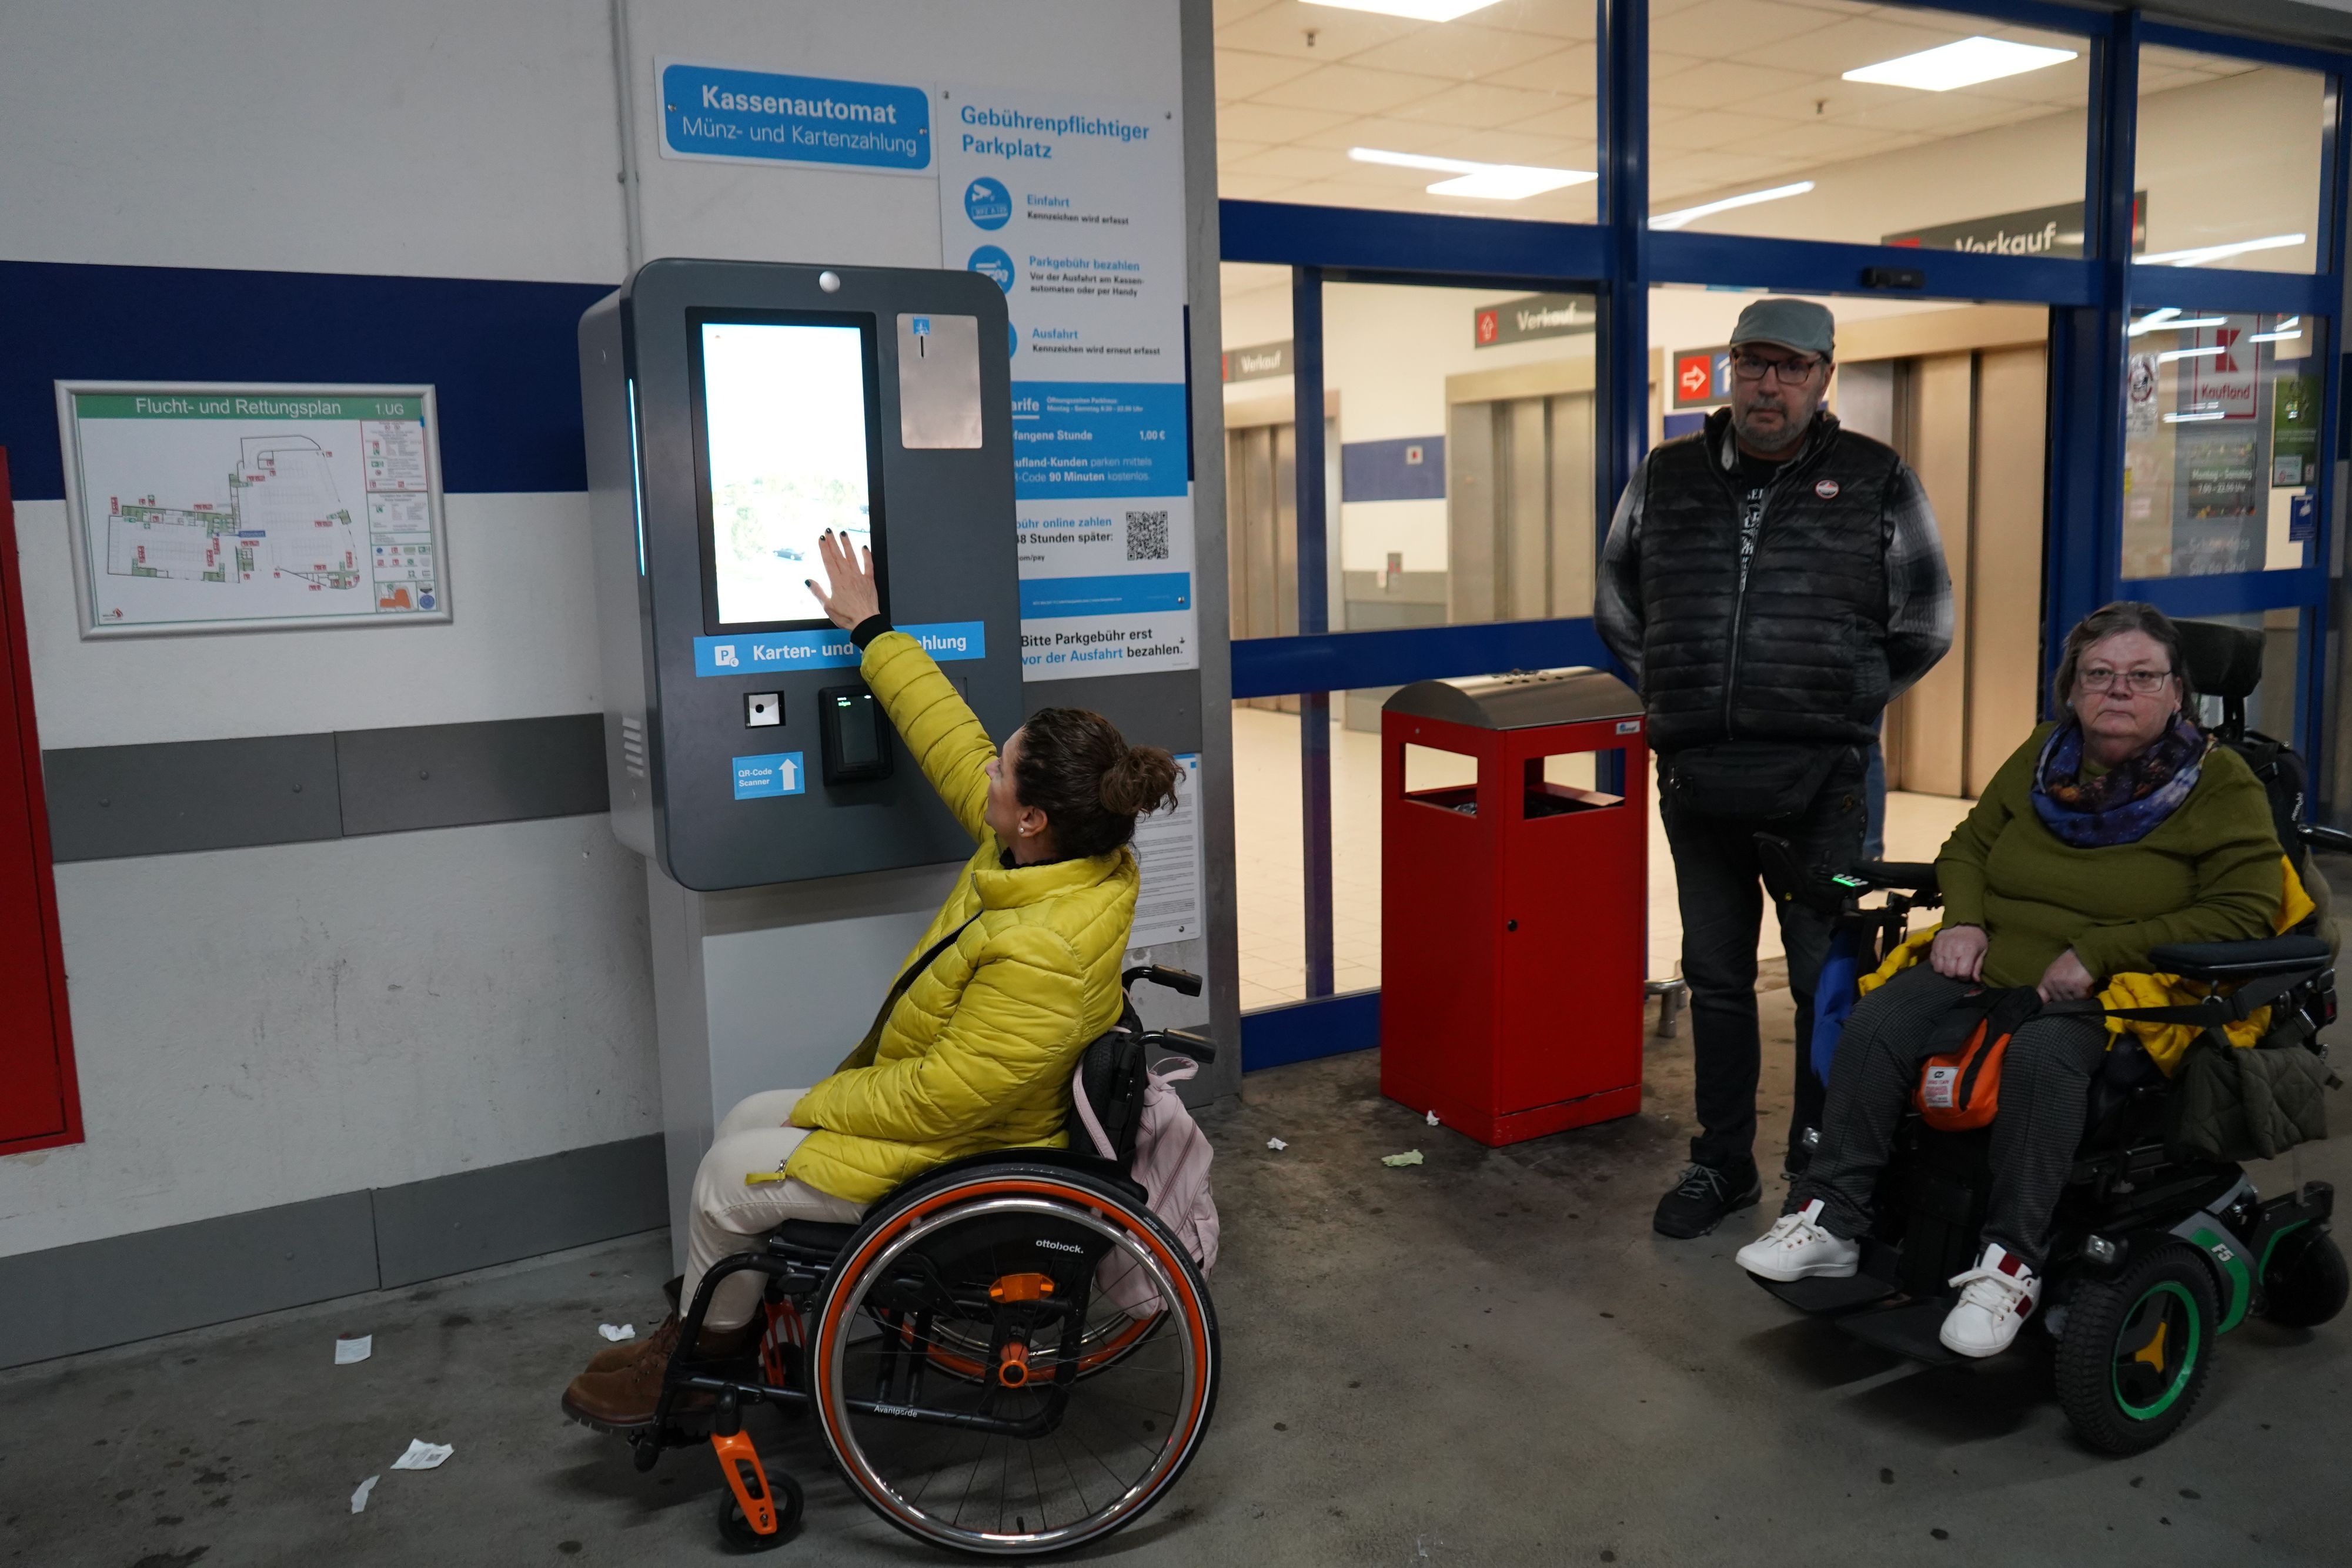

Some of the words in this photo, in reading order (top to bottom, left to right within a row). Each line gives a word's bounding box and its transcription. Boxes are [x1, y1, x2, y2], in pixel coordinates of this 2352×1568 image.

[703, 85, 897, 124] Kassenautomat
[961, 105, 1150, 142] Gebührenpflichtiger
[683, 116, 743, 140] Münz-
[750, 125, 784, 143] und
[793, 125, 917, 158] Kartenzahlung
[962, 134, 1053, 160] Parkplatz
[1027, 194, 1070, 208] Einfahrt
[1027, 211, 1079, 223] Kennzeichen
[1081, 214, 1100, 224] wird
[1102, 216, 1129, 226] erfasst
[1956, 221, 2056, 255] Verkauf
[1030, 255, 1090, 270] Parkgebühr
[1094, 259, 1140, 271] bezahlen
[1030, 272, 1044, 280] Vor
[1047, 272, 1060, 281] der
[1062, 273, 1097, 283] Ausfahrt
[1114, 276, 1144, 285] Kassen-
[1030, 285, 1075, 294] automaten
[1077, 286, 1095, 295] oder
[1097, 288, 1111, 296] per
[1112, 287, 1138, 297] Handy
[1516, 302, 1576, 332] Verkauf
[1032, 327, 1078, 340] Ausfahrt
[1032, 344, 1084, 353] Kennzeichen
[1087, 345, 1104, 354] wird
[1106, 346, 1132, 355] erneut
[1134, 346, 1161, 355] erfasst
[1241, 350, 1282, 372] Verkauf
[2201, 383, 2251, 400] Kaufland
[135, 397, 194, 414] Flucht-
[200, 399, 230, 414] und
[236, 399, 342, 418] Rettungsplan
[376, 402, 404, 415] 1.UG
[1013, 430, 1054, 442] fangene
[1057, 430, 1093, 441] Stunde
[1160, 430, 1165, 440] €
[1014, 457, 1087, 468] ufland-Kunden
[1091, 457, 1120, 468] parken
[1122, 456, 1152, 467] mittels
[1048, 472, 1061, 482] 90
[1064, 471, 1105, 482] Minuten
[1108, 471, 1150, 481] kostenlos.
[1043, 517, 1075, 528] online
[1078, 516, 1112, 527] zahlen
[1030, 532, 1075, 544] Stunden
[1078, 532, 1114, 544] später:
[1021, 635, 1051, 647] Bitte
[1055, 630, 1125, 646] Parkgebühr
[1129, 628, 1152, 640] erst
[753, 644, 817, 661] Karten-
[821, 641, 854, 657] und
[1022, 655, 1041, 666] vor
[1046, 651, 1066, 663] der
[1070, 648, 1123, 662] Ausfahrt
[1127, 644, 1183, 658] bezahlen.
[738, 767, 773, 777] QR-Code
[739, 777, 770, 787] Scanner
[2211, 1243, 2234, 1262] F5
